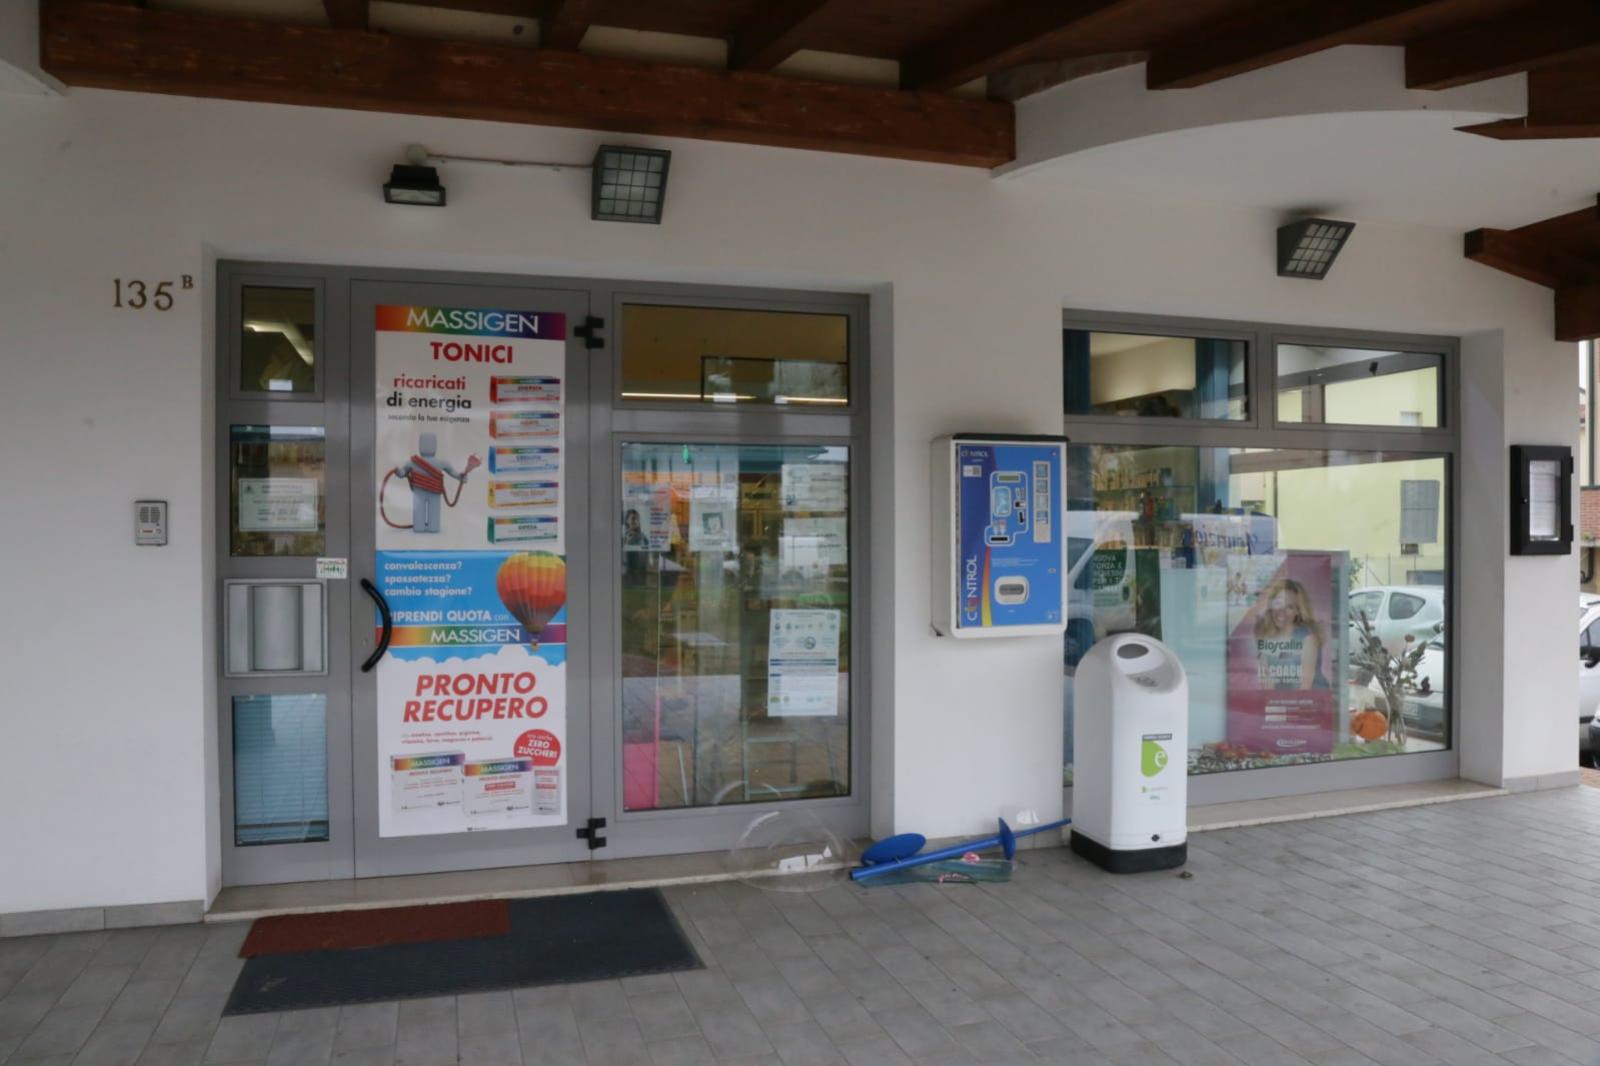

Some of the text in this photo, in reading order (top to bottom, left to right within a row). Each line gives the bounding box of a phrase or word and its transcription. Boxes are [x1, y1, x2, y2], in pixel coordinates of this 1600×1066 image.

[113, 278, 174, 311] 135
[406, 309, 539, 334] MASSIGEN
[430, 341, 514, 364] TONICI
[393, 373, 466, 391] ricaricati
[386, 391, 472, 413] di energia
[384, 561, 463, 571] convalescenza?
[384, 574, 451, 584] spossatezza?
[384, 586, 473, 598] cambio stagione?
[446, 610, 492, 622] QUOTA
[430, 628, 521, 643] MASSIGEN
[416, 671, 537, 697] PRONTO
[403, 696, 548, 722] RECUPERO
[528, 740, 550, 749] ZERO
[518, 746, 558, 760] ZUCCHERI
